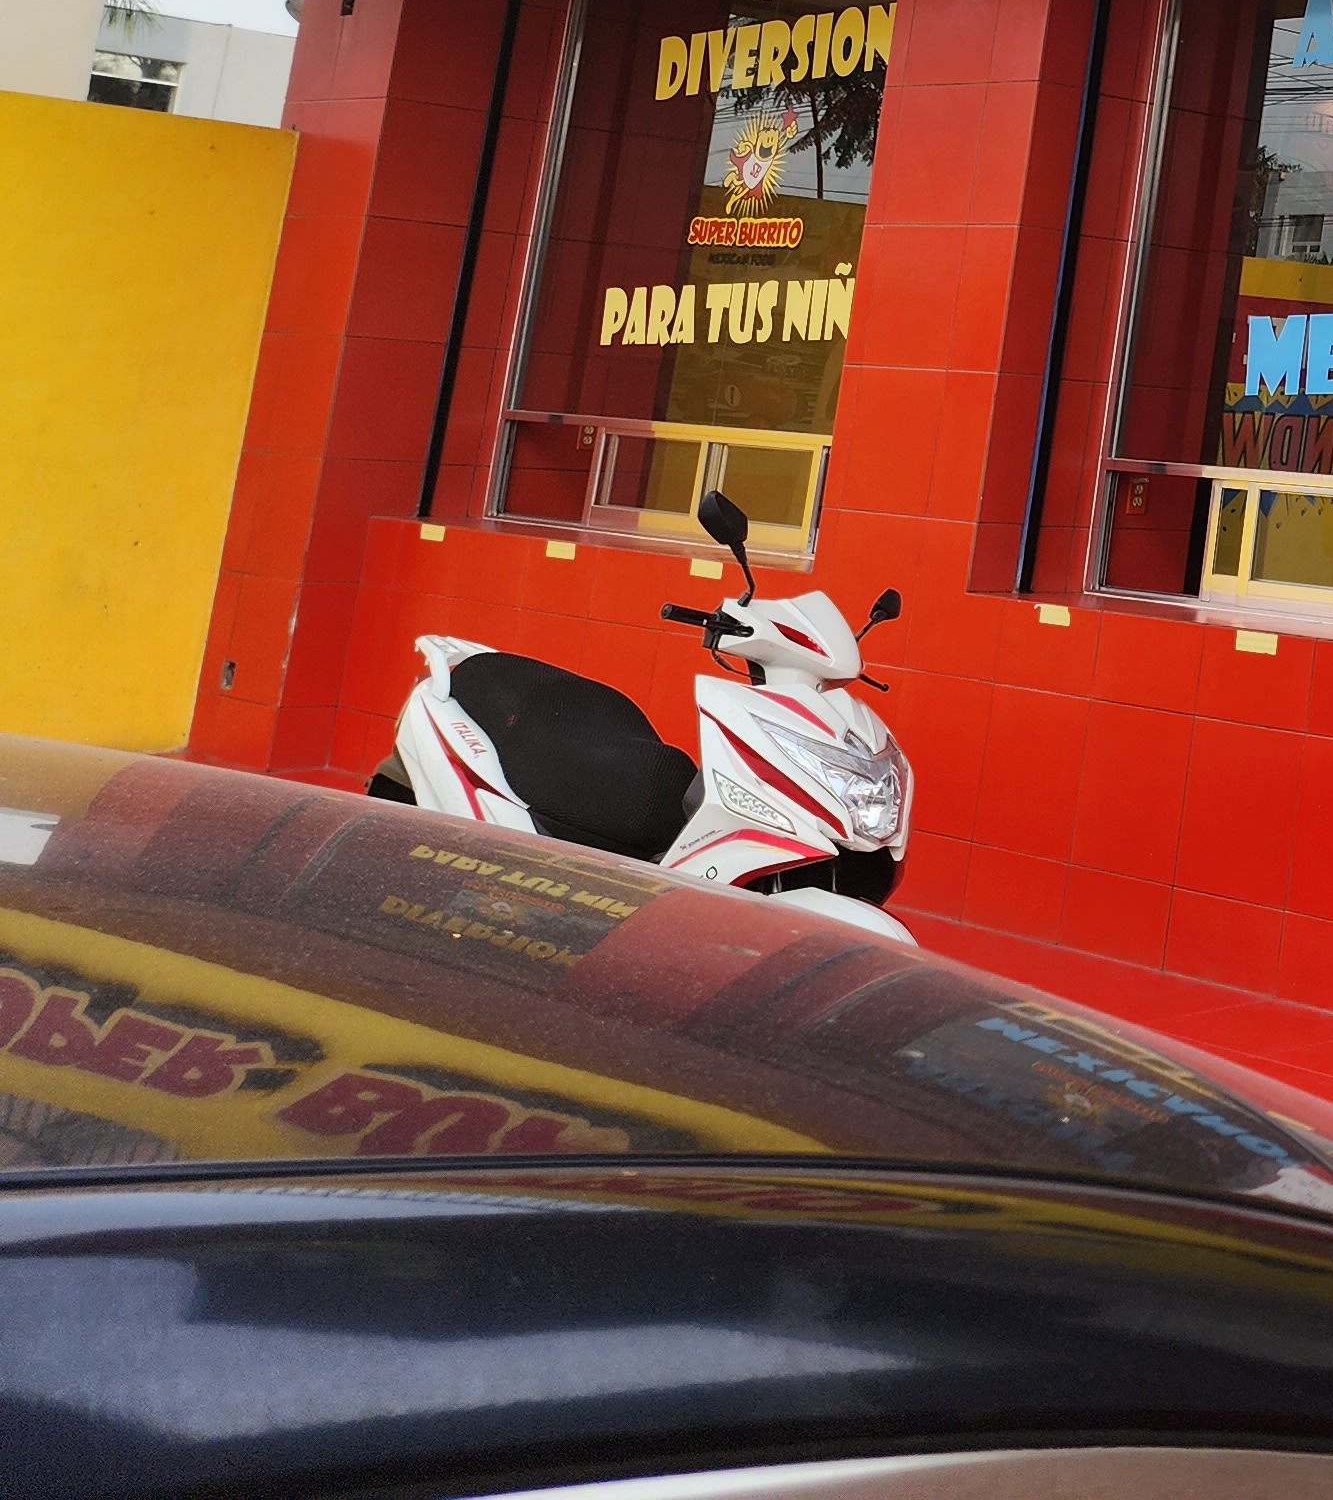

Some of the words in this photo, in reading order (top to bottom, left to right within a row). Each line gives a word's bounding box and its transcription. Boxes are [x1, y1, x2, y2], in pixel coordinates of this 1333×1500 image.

[689, 218, 736, 245] SUPER
[737, 220, 802, 247] BURRITO
[600, 284, 696, 347] PARA
[706, 280, 779, 344] TUS
[451, 722, 487, 754] ITALIKA
